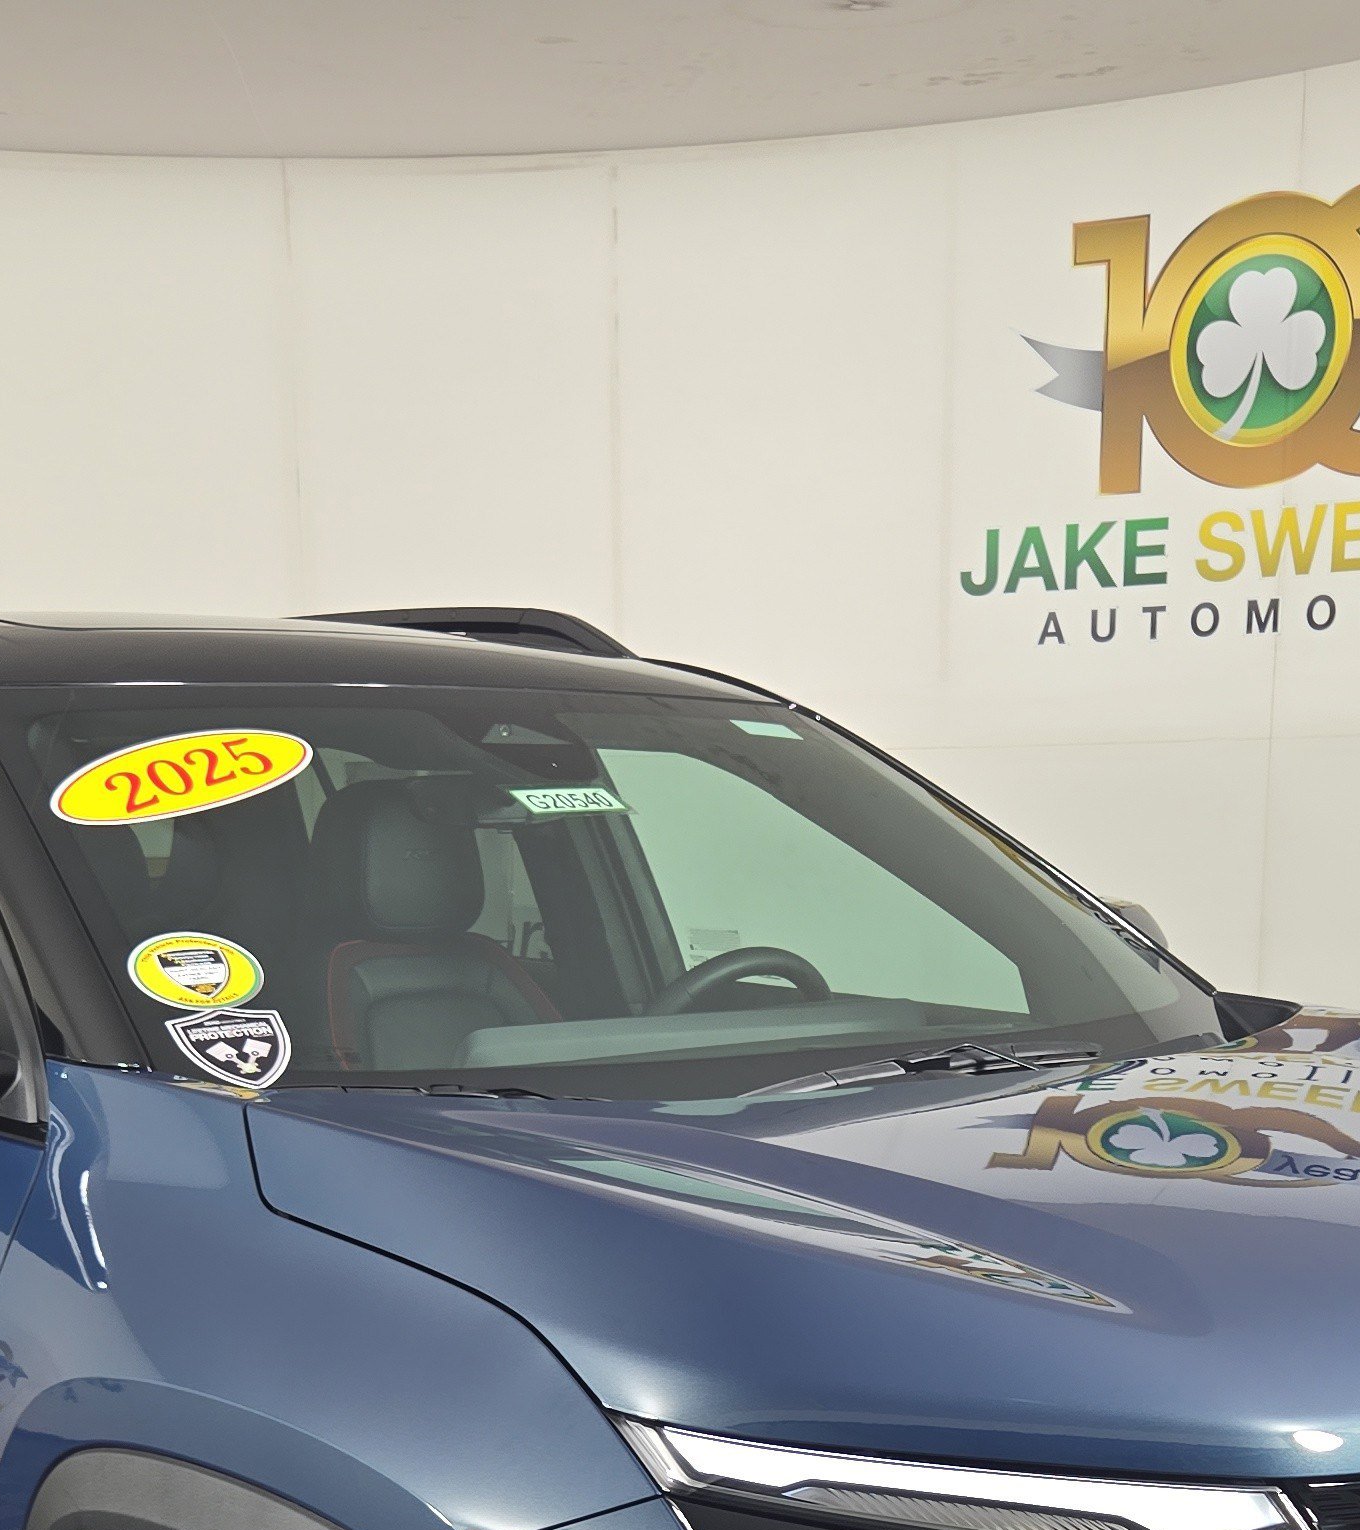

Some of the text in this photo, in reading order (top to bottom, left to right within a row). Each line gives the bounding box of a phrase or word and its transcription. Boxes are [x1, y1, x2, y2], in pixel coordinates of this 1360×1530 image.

[959, 516, 1170, 597] JAKE
[105, 738, 273, 813] 2025
[526, 792, 613, 809] G20540
